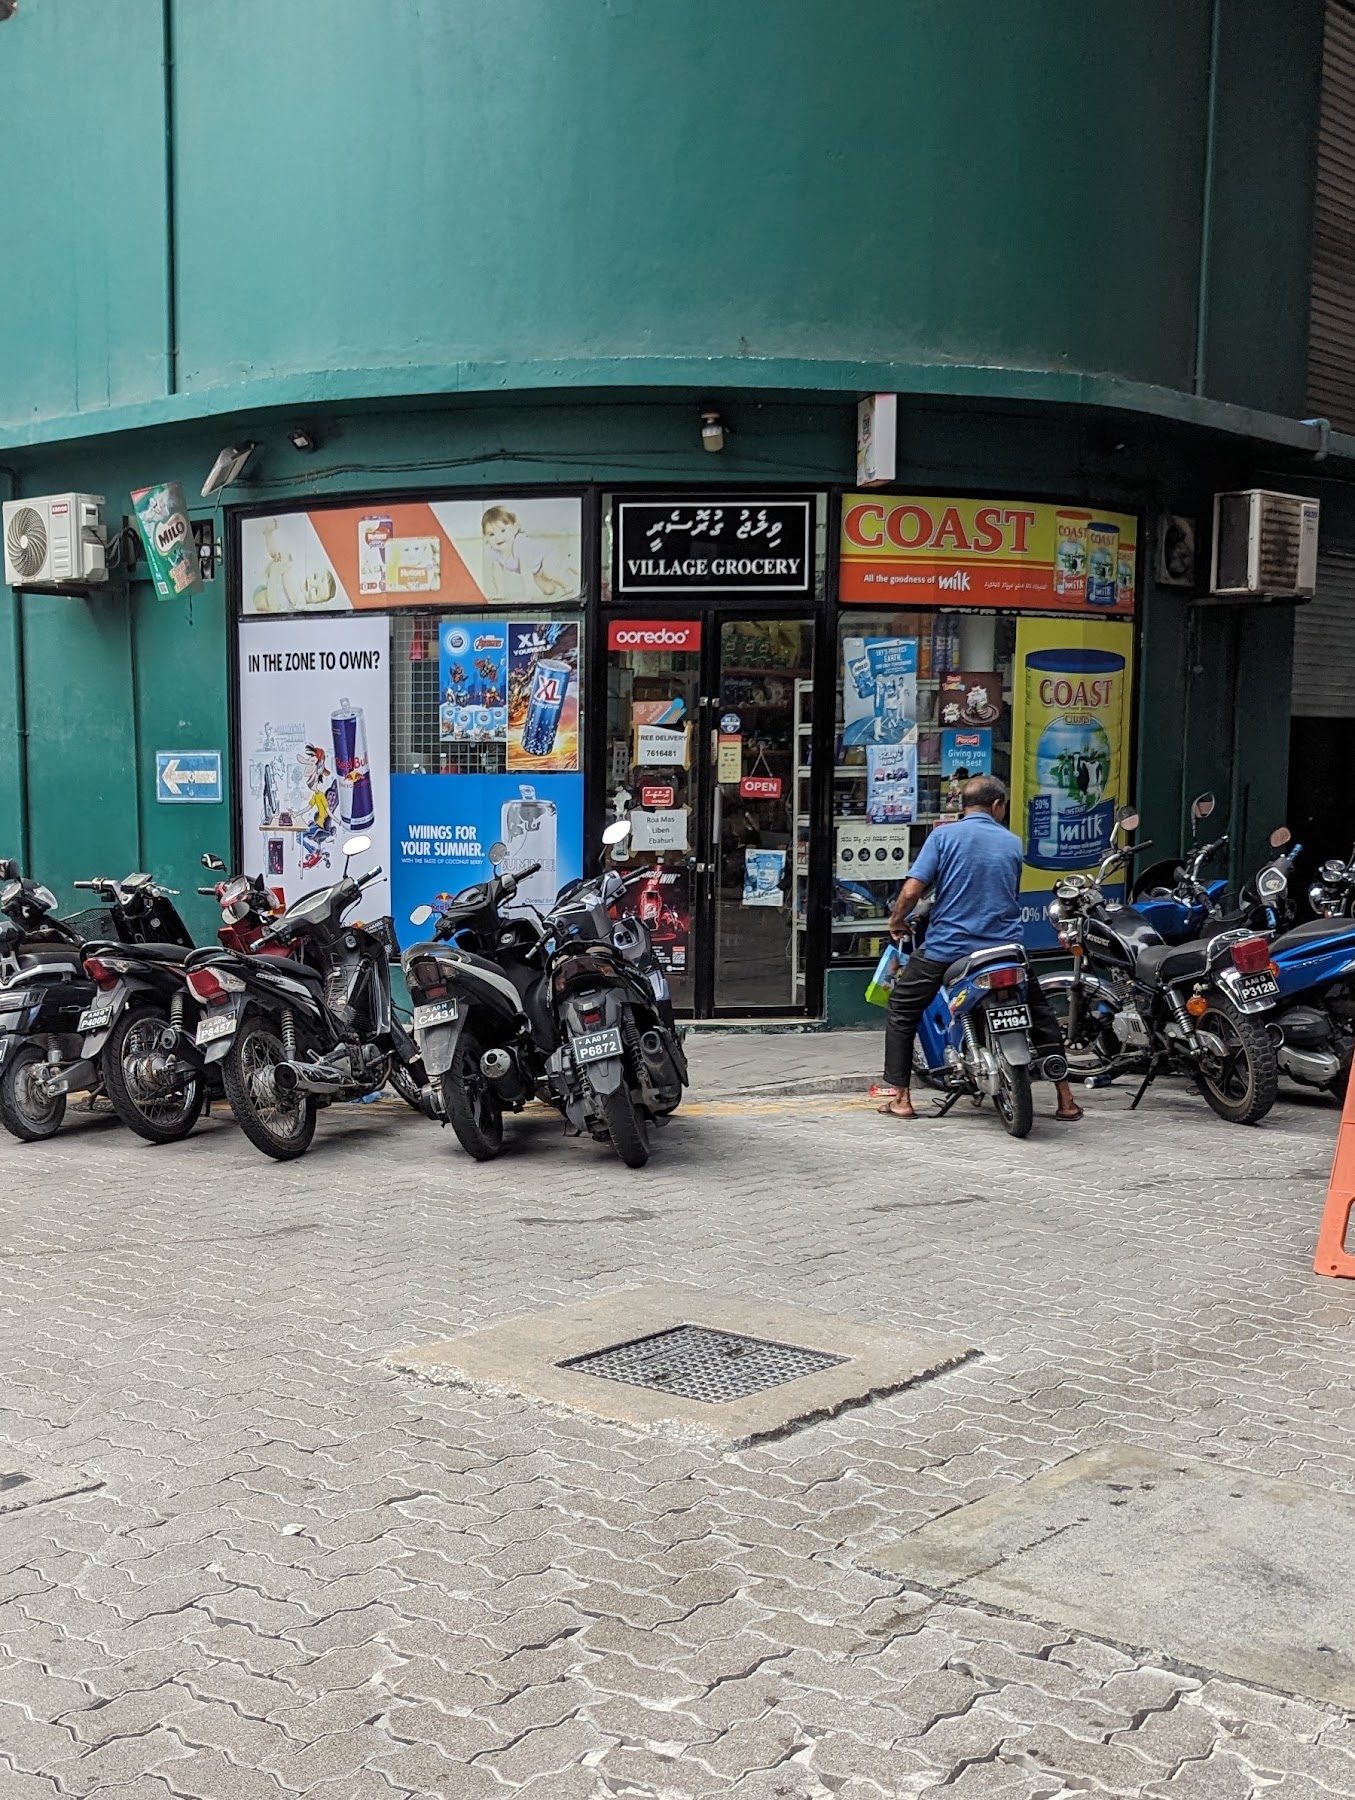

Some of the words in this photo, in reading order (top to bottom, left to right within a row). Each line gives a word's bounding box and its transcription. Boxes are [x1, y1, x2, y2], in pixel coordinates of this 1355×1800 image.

[157, 521, 185, 548] MILO
[843, 503, 1036, 554] COAST
[1058, 525, 1088, 538] COAST
[1090, 533, 1115, 545] COAST
[627, 559, 708, 576] VILLAGE
[711, 558, 801, 575] GROCERY
[863, 574, 874, 583] All
[876, 575, 888, 583] the
[890, 575, 926, 585] goodness
[927, 576, 935, 584] of
[938, 570, 971, 591] milk
[518, 632, 546, 649] XL
[616, 629, 686, 644] ooredoo
[513, 644, 553, 657] YOURSELF
[248, 655, 260, 672] IN
[262, 653, 282, 672] THE
[285, 652, 316, 671] ZONE
[319, 651, 336, 670] TO
[339, 650, 381, 670] OWN?
[535, 675, 561, 704] XL
[1039, 679, 1113, 708] COAST
[948, 749, 971, 759] Giving
[972, 751, 986, 759] you
[952, 759, 965, 767] the
[966, 759, 982, 767] best
[744, 782, 777, 792] OPEN
[1034, 799, 1050, 810] 50%
[646, 816, 659, 824] Roa
[1060, 814, 1103, 842] milk
[409, 825, 451, 840] WIIINGS
[455, 826, 477, 840] FOR
[400, 841, 431, 856] YOUR
[434, 842, 486, 857] SUMMER.
[649, 837, 674, 845] Ebahuri
[1241, 981, 1276, 999] P3128
[81, 1015, 108, 1029] P4006
[418, 1007, 455, 1025] C4431
[992, 1015, 1028, 1030] P1194
[201, 1021, 232, 1040] P8457
[580, 1041, 617, 1059] P6872
